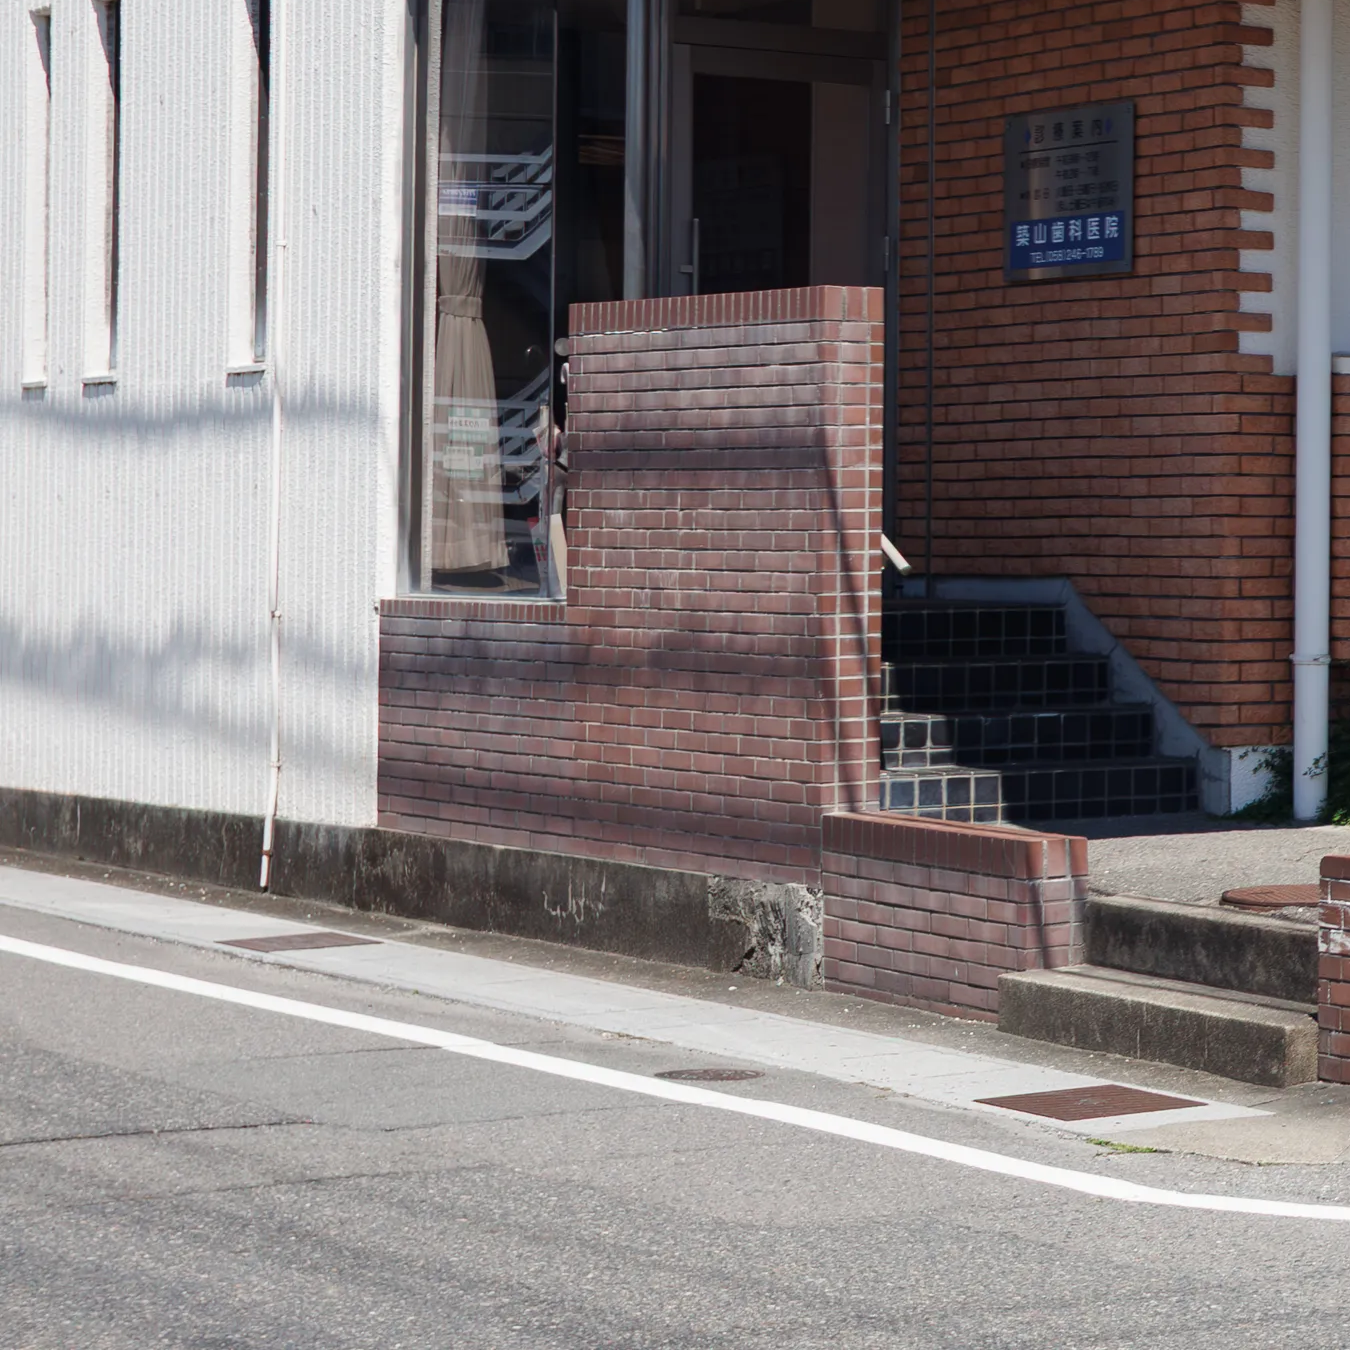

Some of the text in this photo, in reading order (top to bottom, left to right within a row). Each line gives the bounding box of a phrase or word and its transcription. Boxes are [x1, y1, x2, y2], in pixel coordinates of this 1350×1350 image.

[1015, 215, 1119, 247] 築山歯科医院
